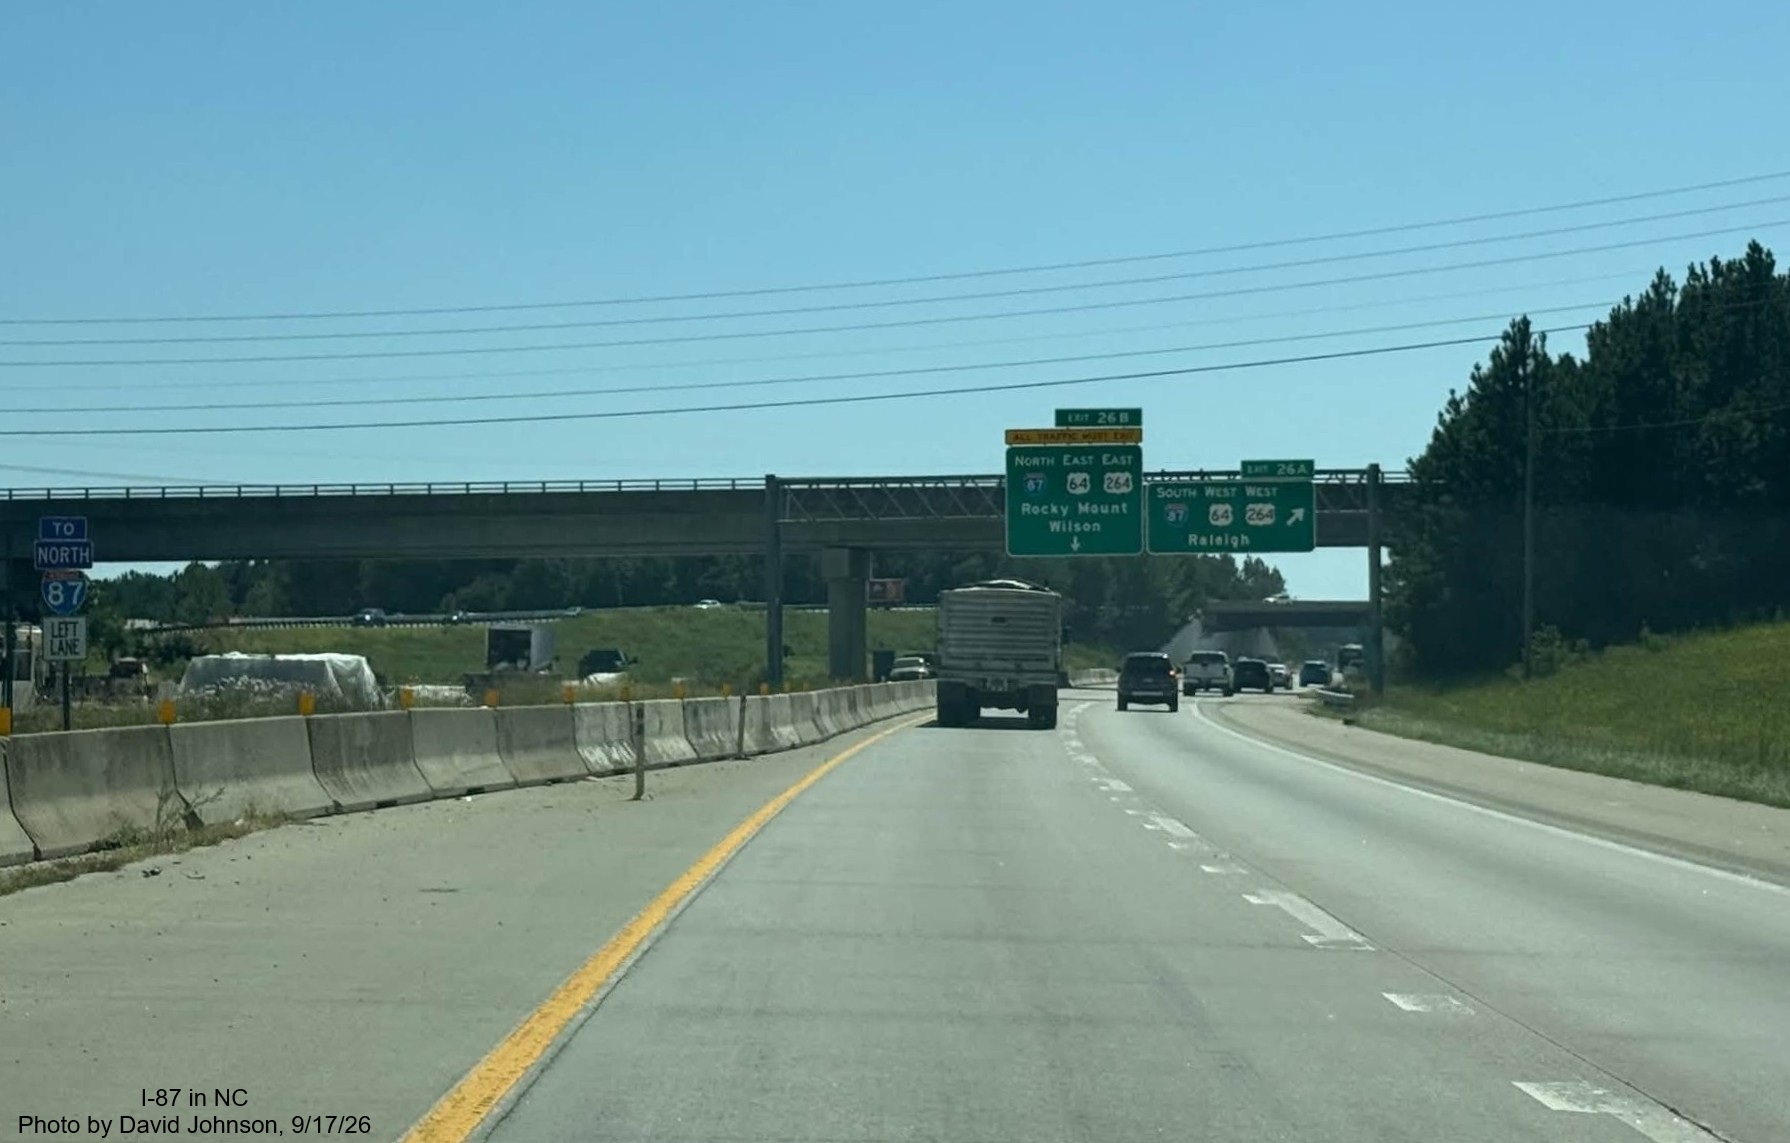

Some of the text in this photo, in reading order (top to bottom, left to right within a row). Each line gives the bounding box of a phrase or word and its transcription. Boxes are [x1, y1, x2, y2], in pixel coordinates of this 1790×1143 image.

[1068, 413, 1089, 423] EXIT
[1014, 431, 1134, 441] ALL TRAFFIC MUST EXIT
[1015, 454, 1134, 465] NORTH EAST EAST
[1247, 464, 1307, 475] EXIT 26A
[1026, 480, 1043, 490] 87
[1069, 477, 1088, 490] 64
[1106, 477, 1131, 490] 264
[1157, 486, 1278, 498] SOUTH WEST WEST
[1022, 503, 1128, 516] Rocky Mount
[1167, 511, 1184, 521] 87
[1211, 508, 1230, 521] 64
[1247, 508, 1274, 521] 264
[53, 522, 75, 536] TO
[1049, 521, 1101, 532] Wilson
[1188, 534, 1250, 548] Raleigh
[38, 547, 90, 564] NORTH
[48, 582, 83, 606] 87
[51, 622, 79, 638] LEFT
[50, 639, 79, 656] LANE
